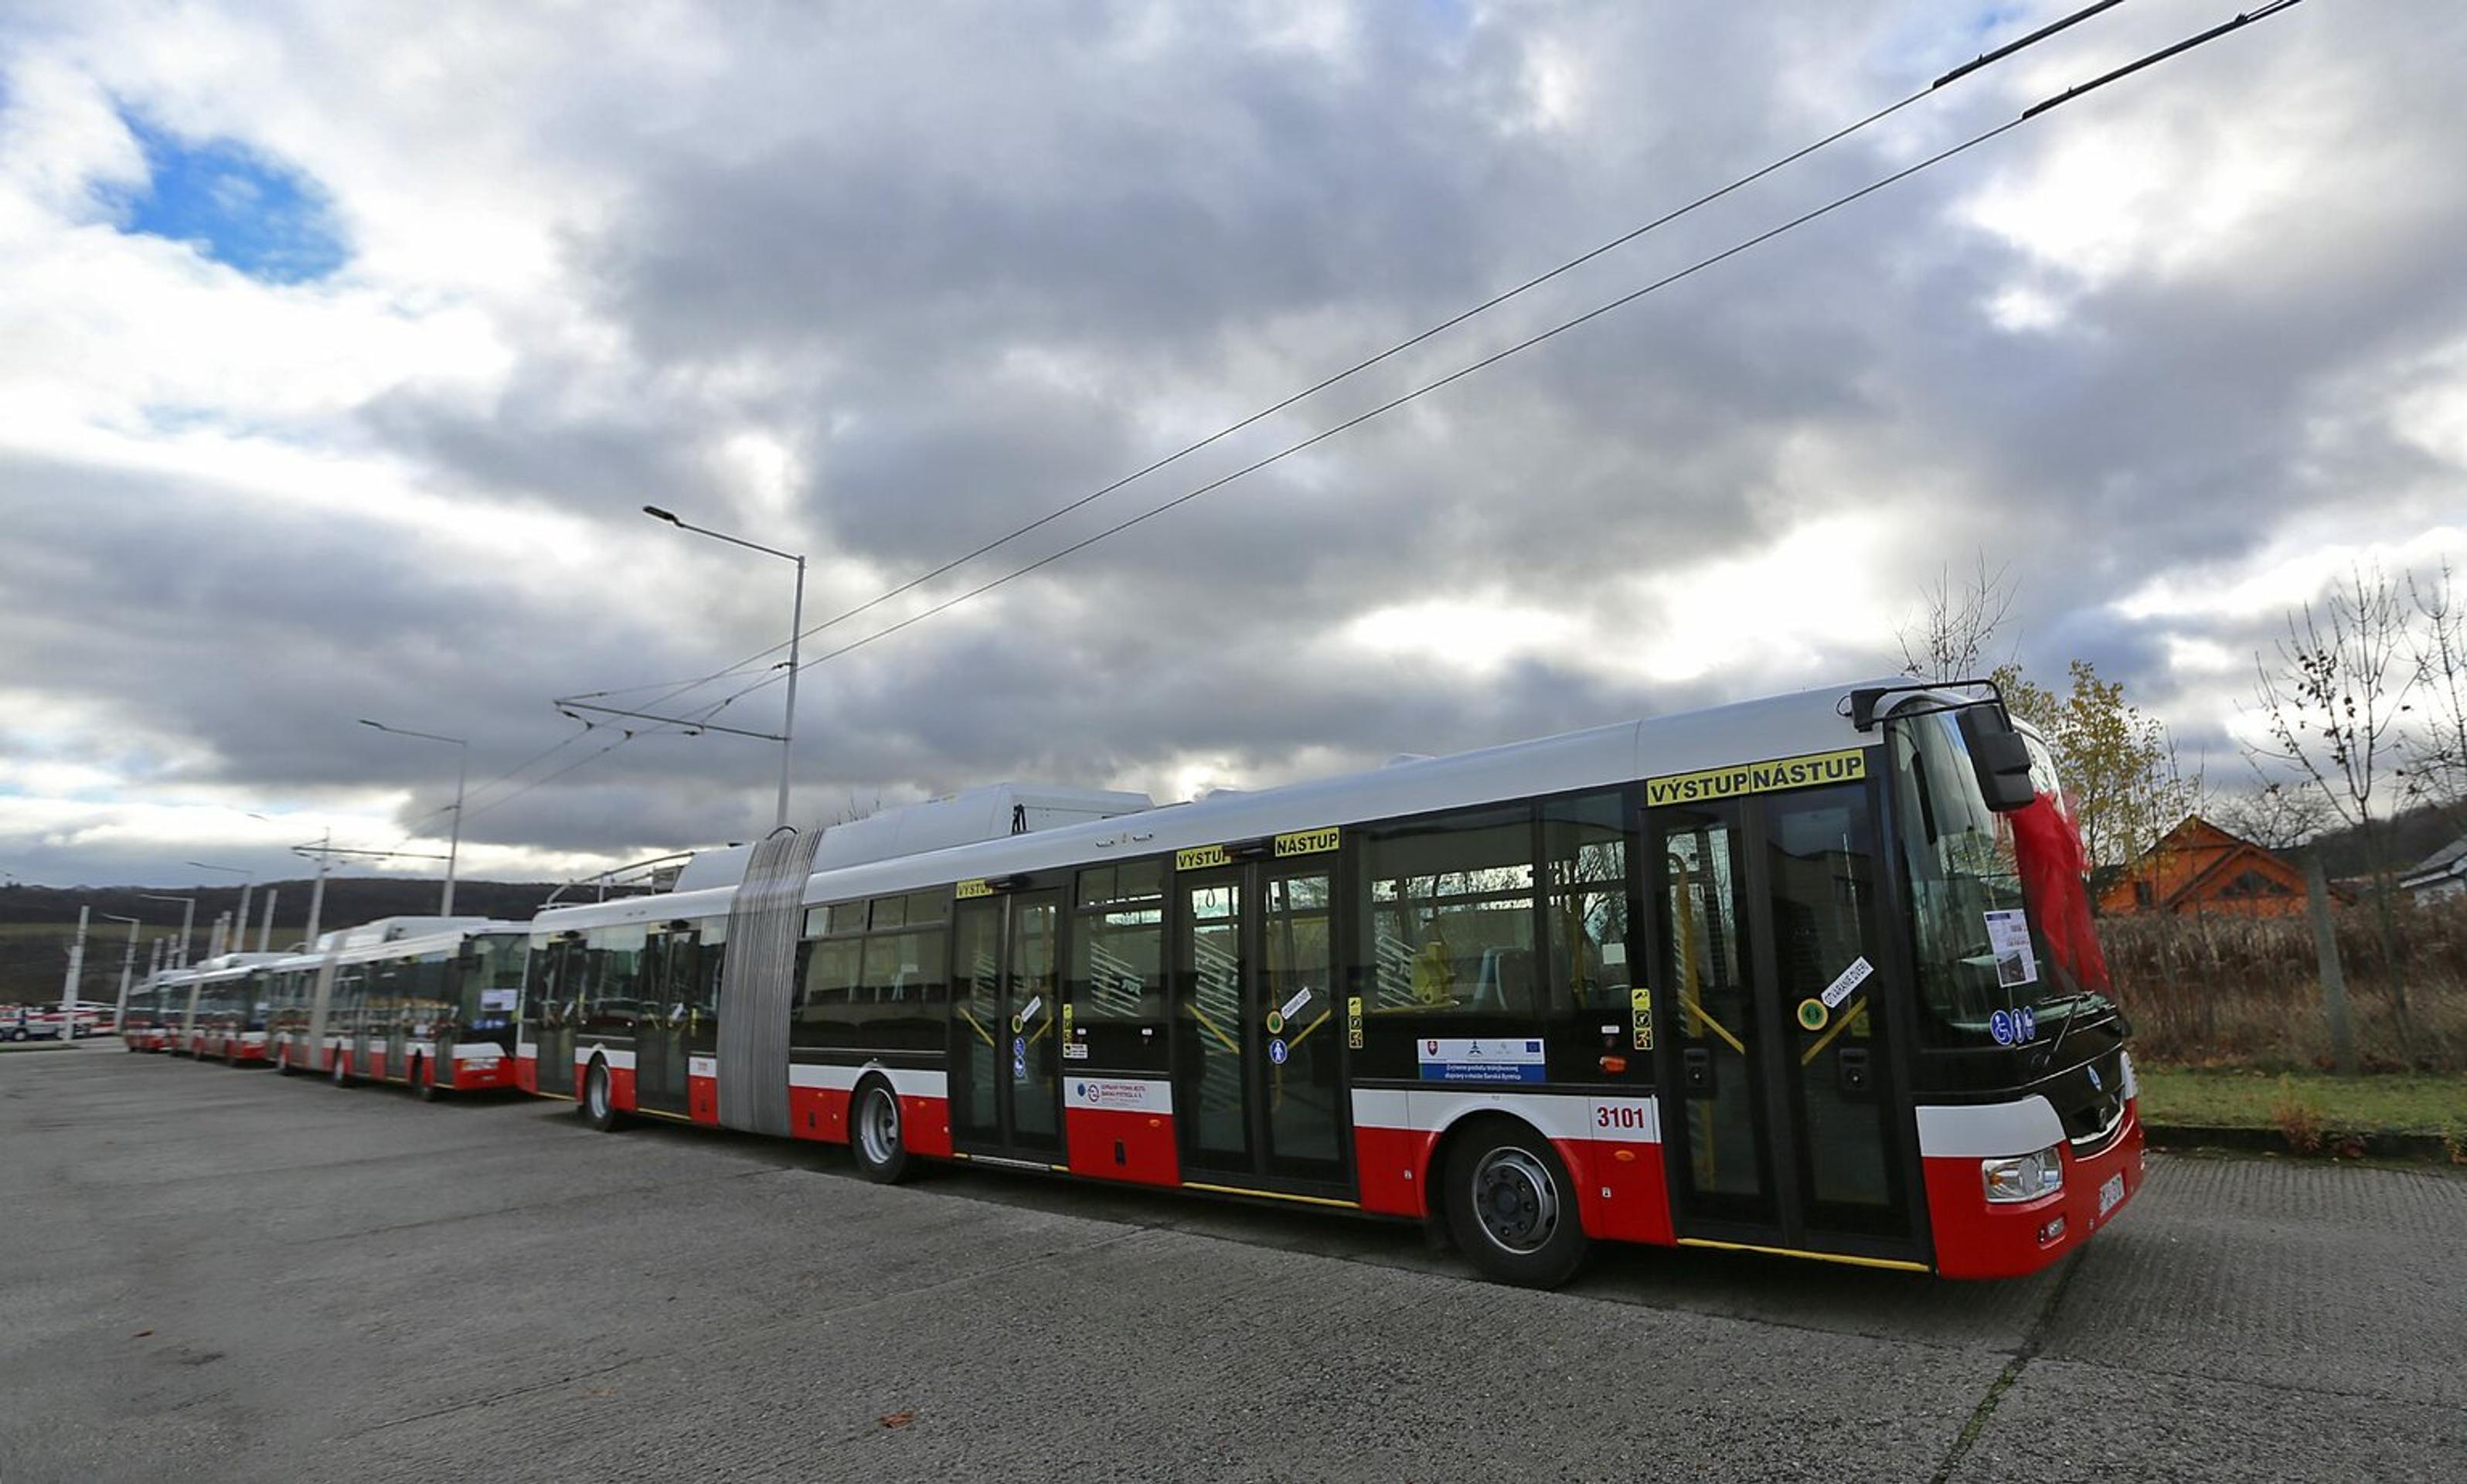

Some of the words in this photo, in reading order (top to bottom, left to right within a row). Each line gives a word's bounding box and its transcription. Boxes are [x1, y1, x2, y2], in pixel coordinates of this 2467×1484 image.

[1650, 771, 1748, 802] VÝSTUP
[1753, 755, 1862, 789] NÁSTUP
[1277, 832, 1338, 855] NÁSTUP
[1597, 1105, 1644, 1128] 3101
